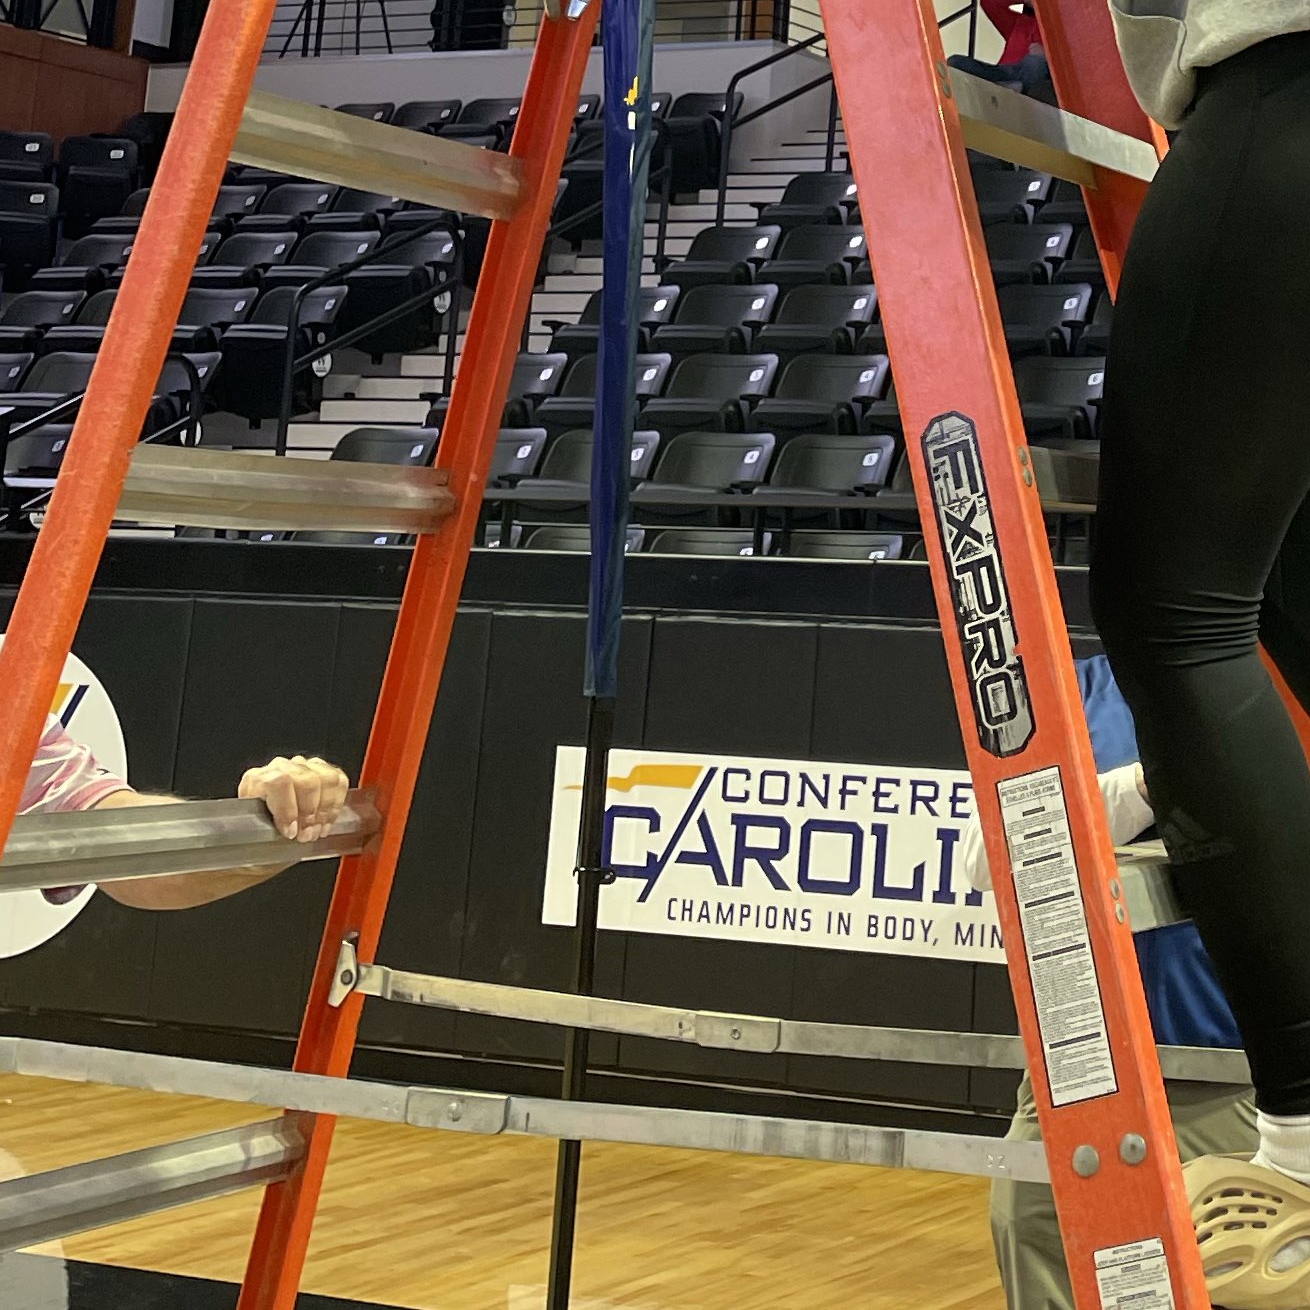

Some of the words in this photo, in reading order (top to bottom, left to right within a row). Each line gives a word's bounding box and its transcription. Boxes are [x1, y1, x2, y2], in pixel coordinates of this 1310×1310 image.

[667, 897, 812, 932] CHAMPIONS
[827, 911, 851, 937] IN
[867, 915, 938, 946] BODY,
